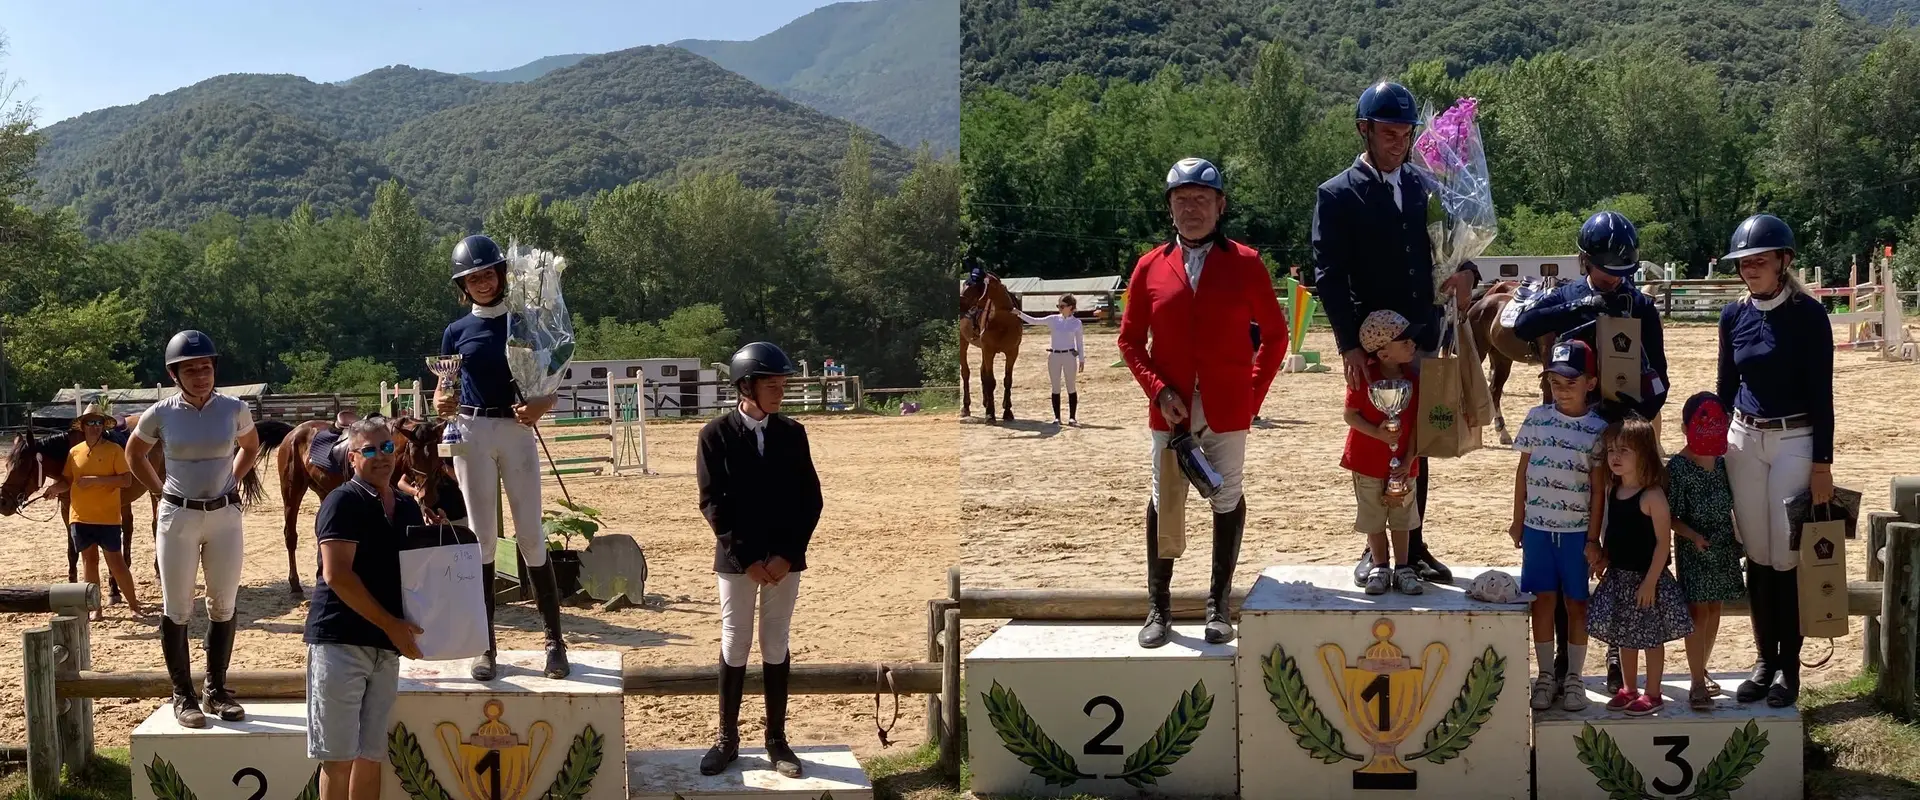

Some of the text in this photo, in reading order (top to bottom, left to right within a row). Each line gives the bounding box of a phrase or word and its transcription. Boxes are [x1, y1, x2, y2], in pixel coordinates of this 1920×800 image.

[1083, 696, 1124, 755] 2
[1361, 676, 1390, 731] 1
[232, 767, 267, 800] 2
[475, 750, 501, 800] 1
[1652, 736, 1693, 795] 3
